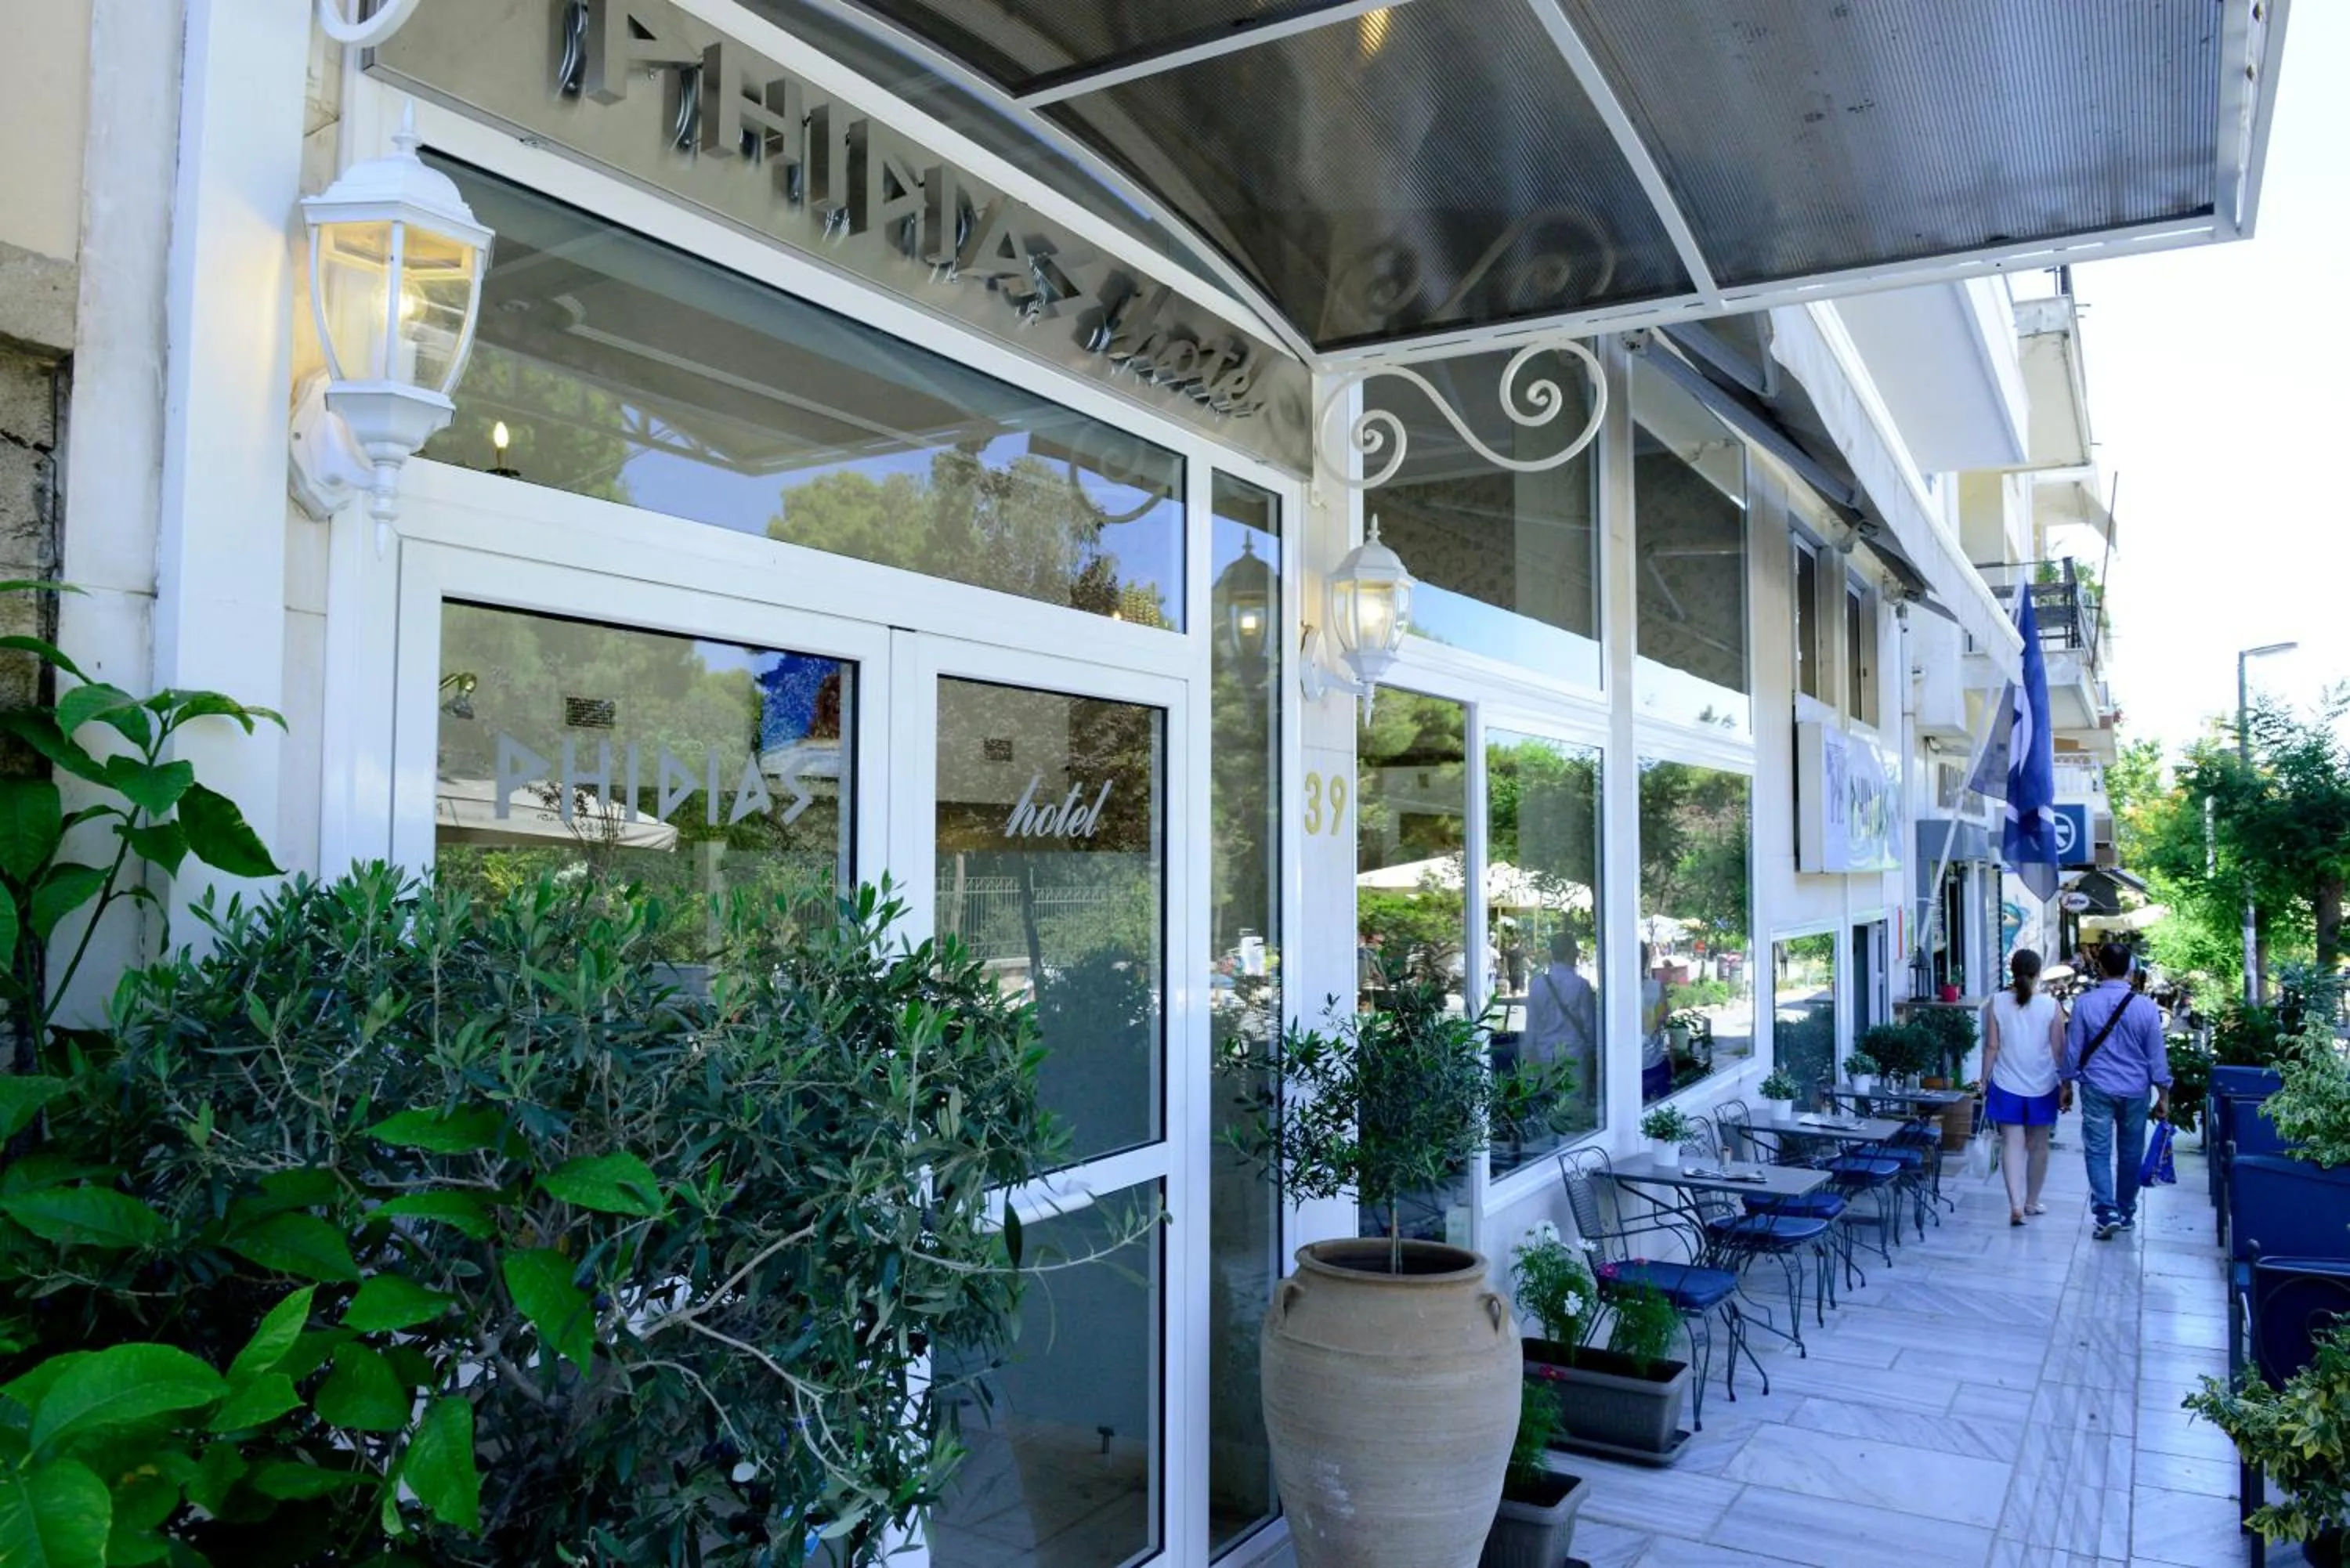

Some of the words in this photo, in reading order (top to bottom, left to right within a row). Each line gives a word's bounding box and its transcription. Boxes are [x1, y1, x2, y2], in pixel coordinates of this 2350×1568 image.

[1111, 285, 1271, 418] hotel
[495, 730, 813, 826] PHIDIAS
[1005, 771, 1112, 838] hotel
[1303, 771, 1347, 836] 39
